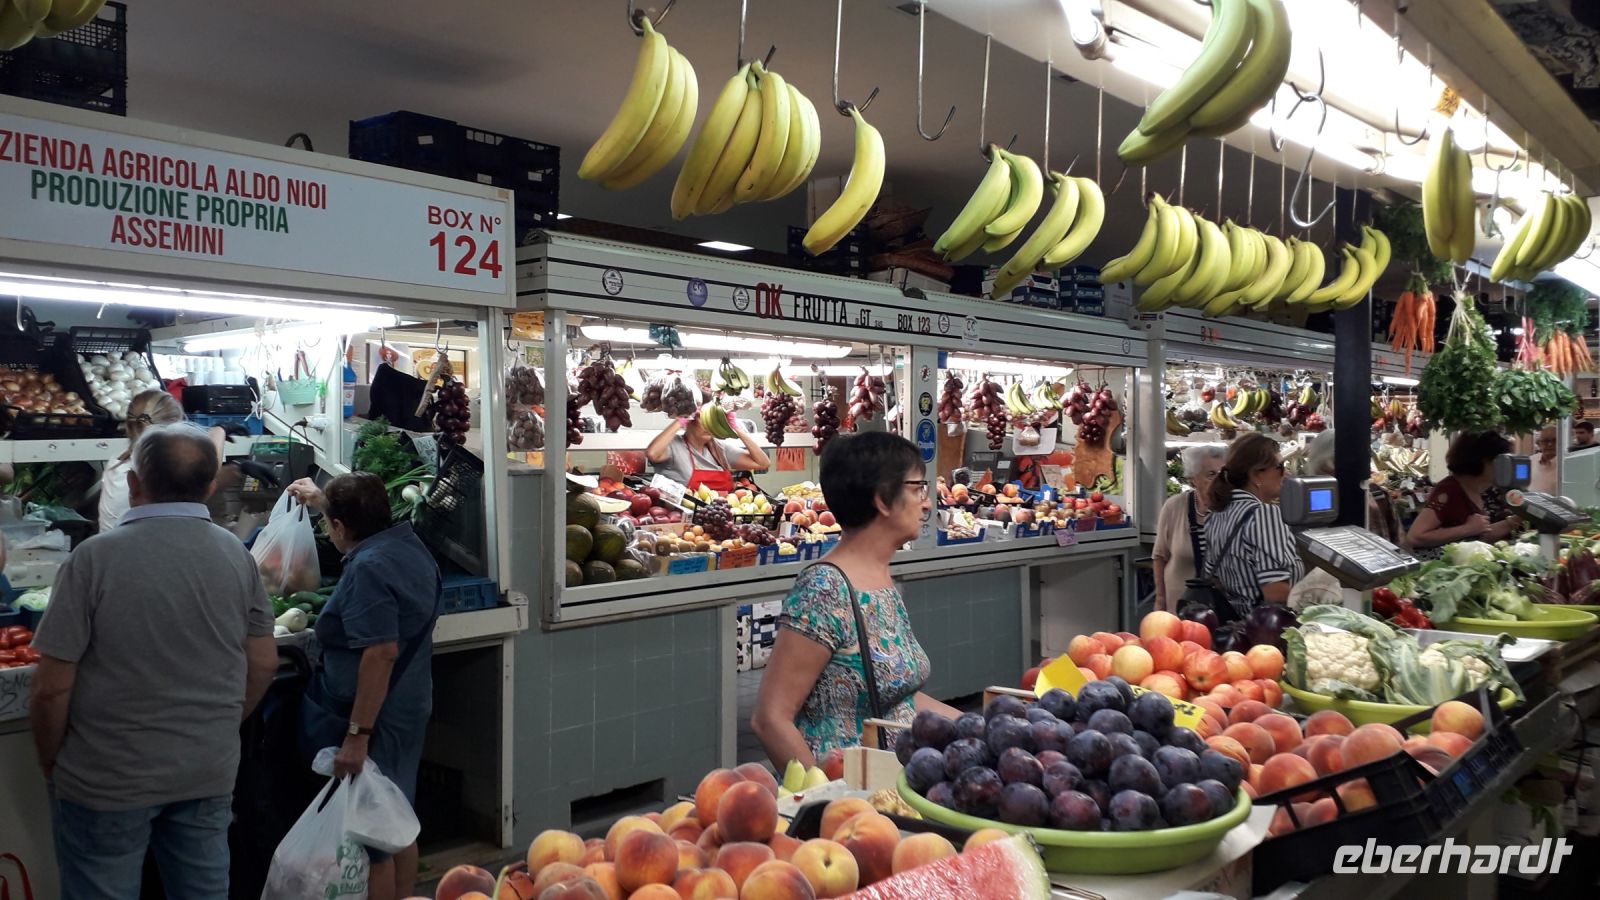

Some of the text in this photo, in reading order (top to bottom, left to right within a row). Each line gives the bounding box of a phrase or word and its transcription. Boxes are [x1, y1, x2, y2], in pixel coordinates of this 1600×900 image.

[0, 130, 327, 209] ZIENDA AGRICOLA ALDO NIOI
[31, 169, 289, 234] PRODUZIONE PROPRIA
[428, 206, 502, 235] BOX N°
[111, 215, 224, 256] ASSEMINI
[429, 231, 503, 279] 124
[755, 283, 784, 320] OK
[794, 294, 848, 326] FRUTTA
[860, 308, 871, 327] GT
[897, 313, 913, 332] BOX
[918, 316, 931, 334] 123
